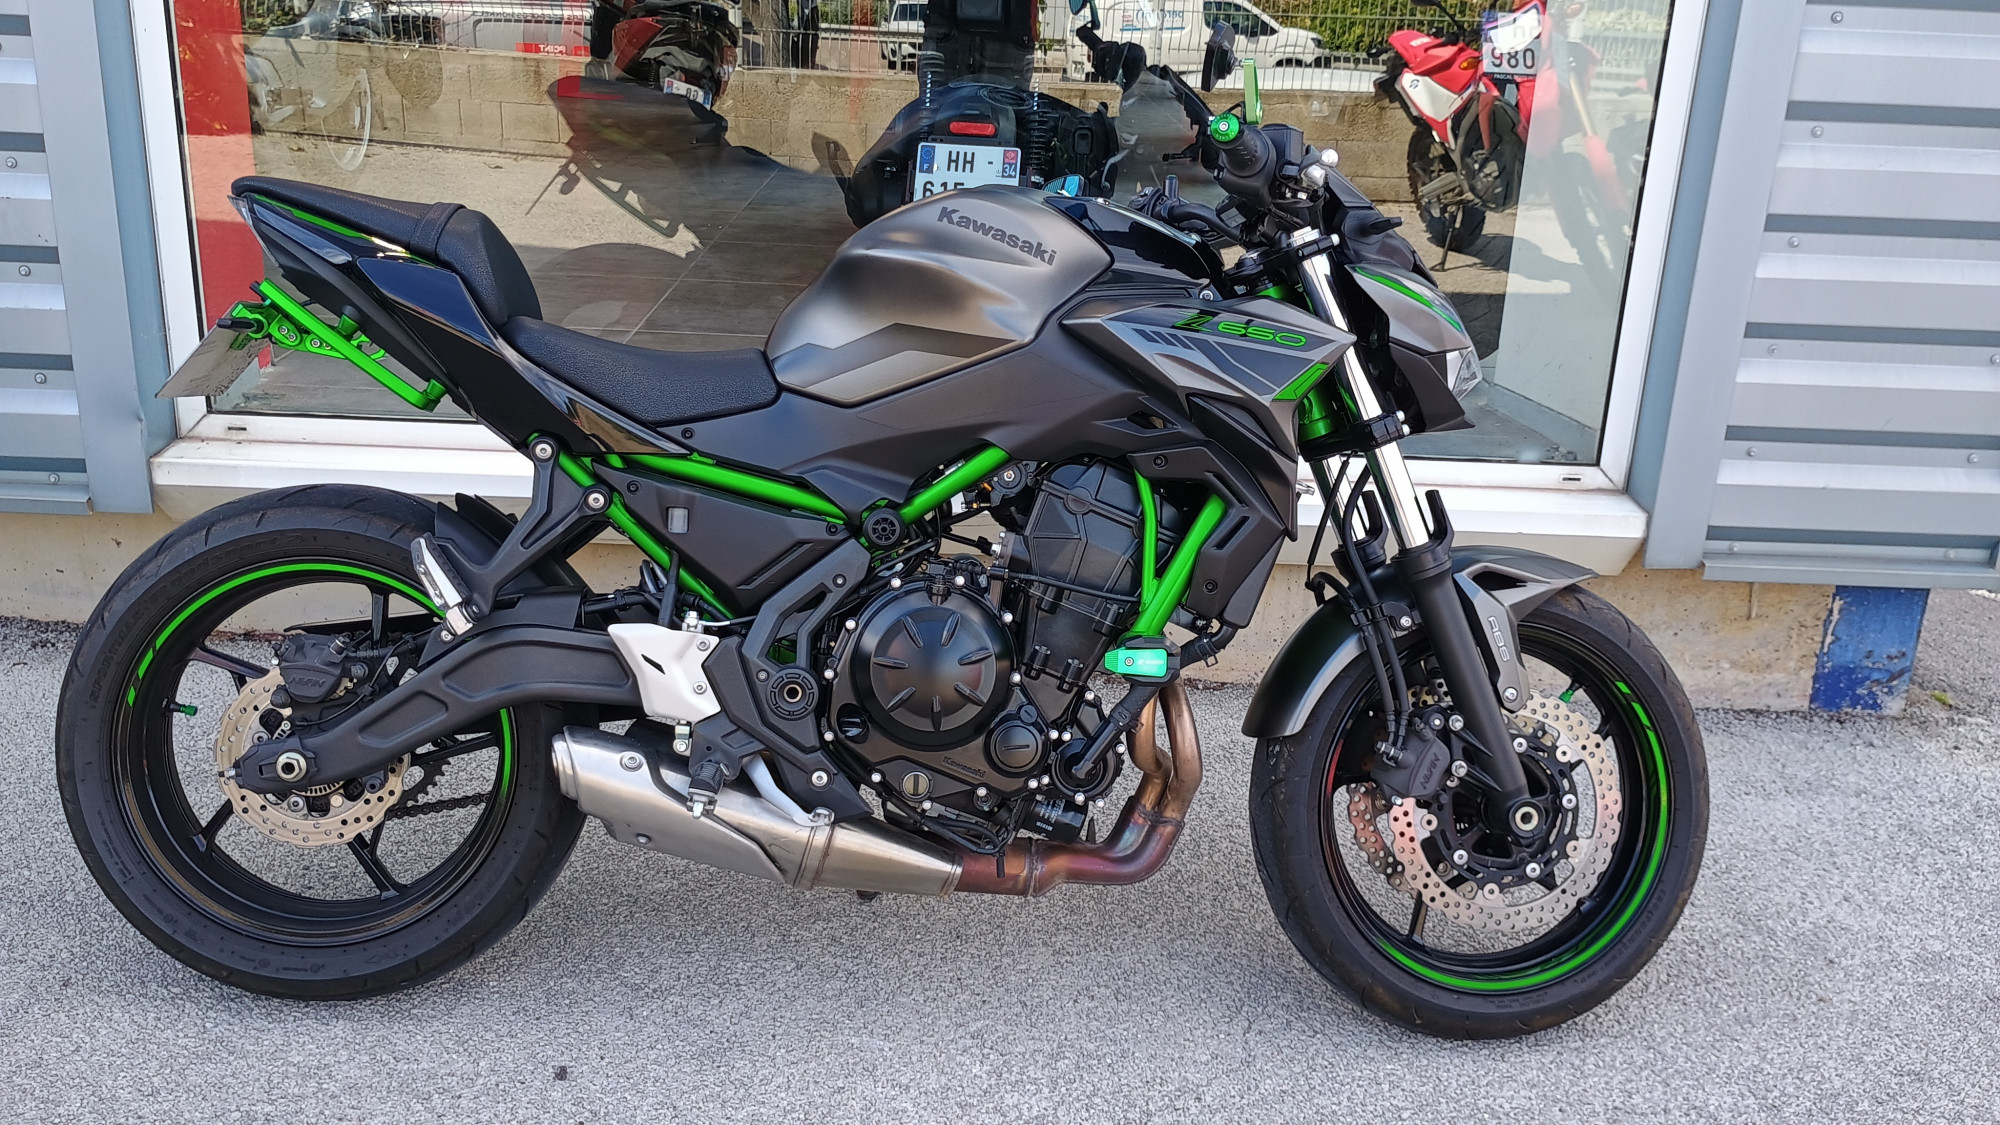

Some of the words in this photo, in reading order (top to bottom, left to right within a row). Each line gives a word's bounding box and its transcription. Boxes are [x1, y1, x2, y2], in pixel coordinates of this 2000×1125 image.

[1491, 46, 1535, 70] 980
[946, 150, 975, 173] HH
[1002, 165, 1016, 177] 34
[937, 206, 1057, 266] Kawasaki
[1173, 312, 1213, 333] Z
[1218, 321, 1307, 347] 650
[1487, 616, 1510, 661] ABS
[942, 755, 986, 779] Kawasaki
